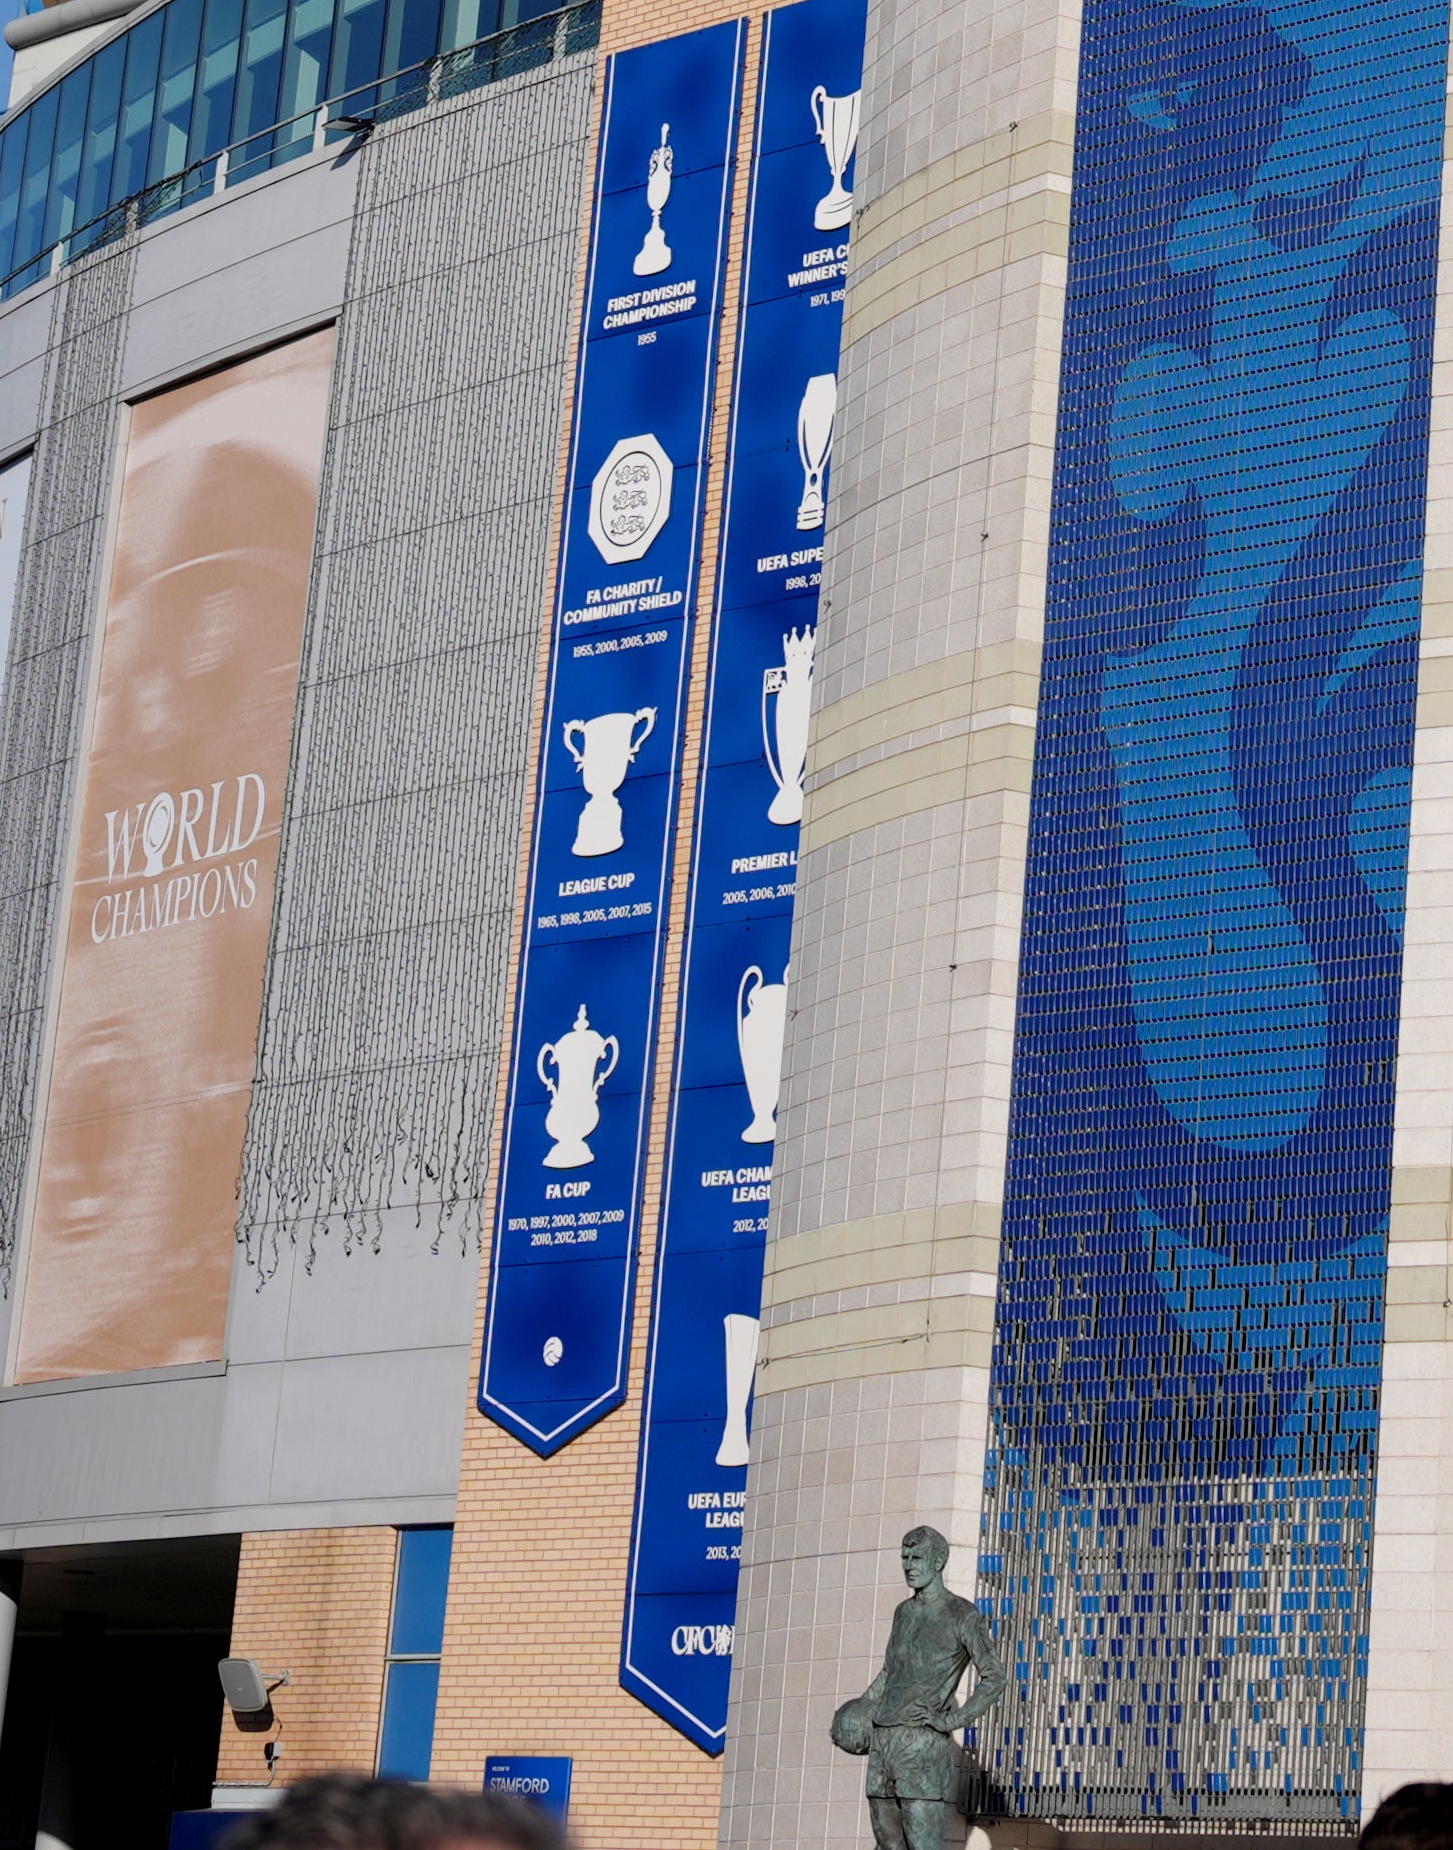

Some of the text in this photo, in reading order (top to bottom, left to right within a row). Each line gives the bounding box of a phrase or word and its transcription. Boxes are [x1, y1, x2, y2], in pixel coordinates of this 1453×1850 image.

[802, 247, 835, 267] UEFA
[607, 279, 696, 312] FIRST DIVISION
[603, 296, 697, 330] CHAMPIONSHIP
[637, 331, 657, 346] 1955
[757, 554, 789, 573] UEFA
[586, 589, 601, 605] FA
[603, 577, 656, 601] CHARITY
[563, 590, 682, 625] COMMUNITY SHIELD
[645, 630, 668, 645] 2009
[731, 852, 788, 874] PREMIER
[558, 872, 635, 897] LEAGUE CUP
[91, 858, 258, 944] CHAMPIONS
[722, 890, 748, 905] 2005,
[749, 886, 776, 901] 2006,
[632, 902, 652, 916] 2015
[701, 1170, 734, 1187] UEFA
[545, 1181, 591, 1200] FA CUP
[577, 1229, 598, 1243] 2018
[688, 1492, 722, 1509] UEFA
[706, 1546, 729, 1561] 2013,
[490, 1777, 550, 1794] STAMFORD
